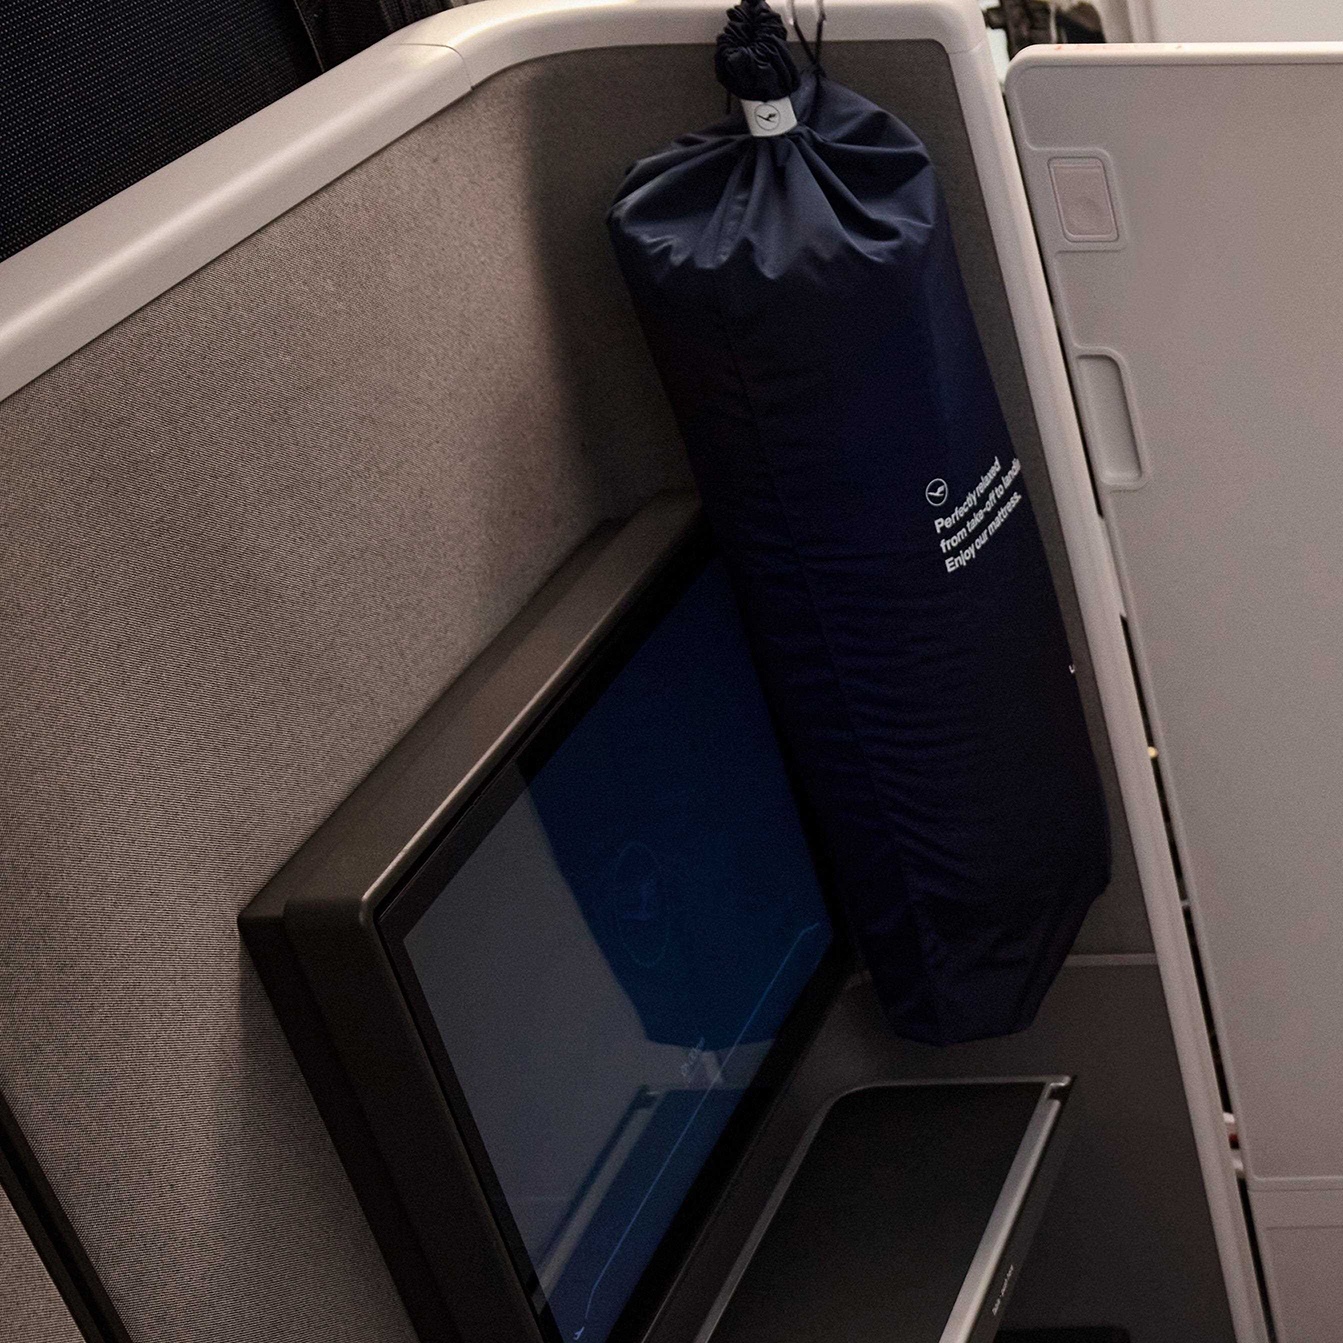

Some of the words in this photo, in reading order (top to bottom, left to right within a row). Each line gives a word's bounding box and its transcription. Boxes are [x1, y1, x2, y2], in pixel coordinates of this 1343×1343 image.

[934, 491, 977, 534] Perfectly
[975, 456, 1002, 497] relaxed
[939, 527, 967, 554] from
[966, 491, 997, 533] take-off
[994, 483, 1005, 500] to
[945, 545, 975, 573] Enjoy
[974, 529, 989, 550] our
